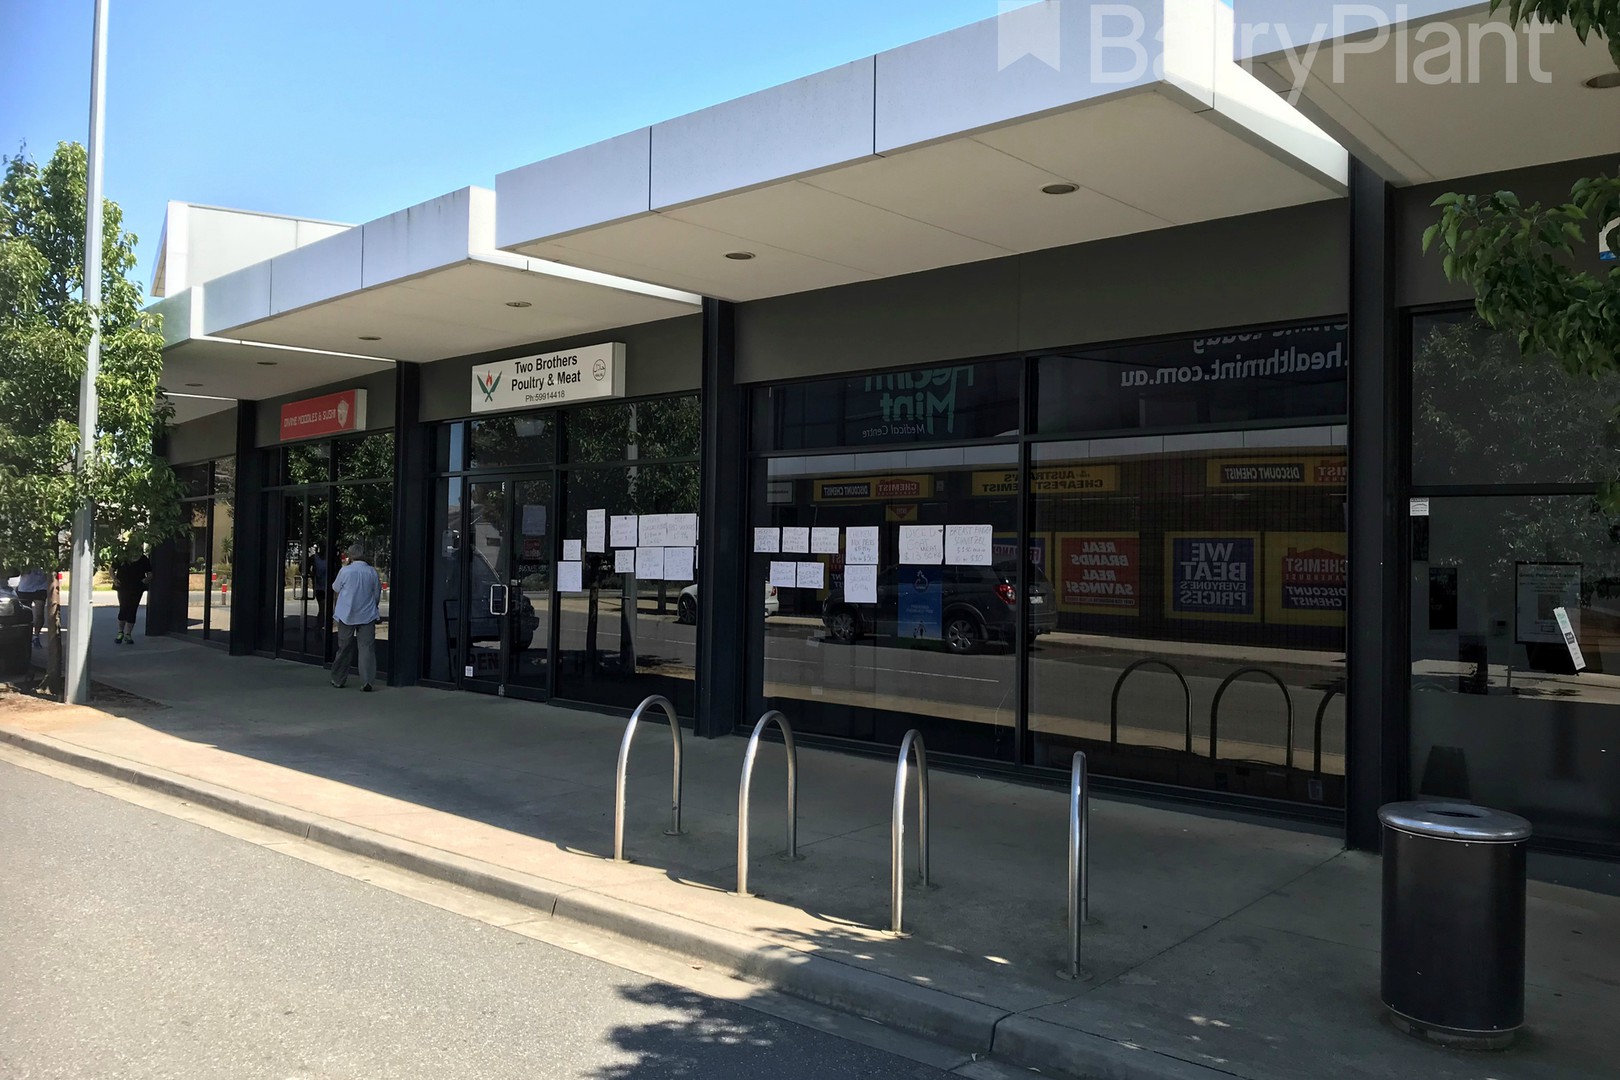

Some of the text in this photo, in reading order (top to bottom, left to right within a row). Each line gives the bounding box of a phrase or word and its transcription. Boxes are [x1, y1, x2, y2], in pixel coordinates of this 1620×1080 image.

[515, 361, 533, 374] Two
[536, 355, 578, 371] Brothers
[511, 376, 545, 391] Poultry
[547, 373, 555, 386] &
[557, 370, 581, 385] Meat
